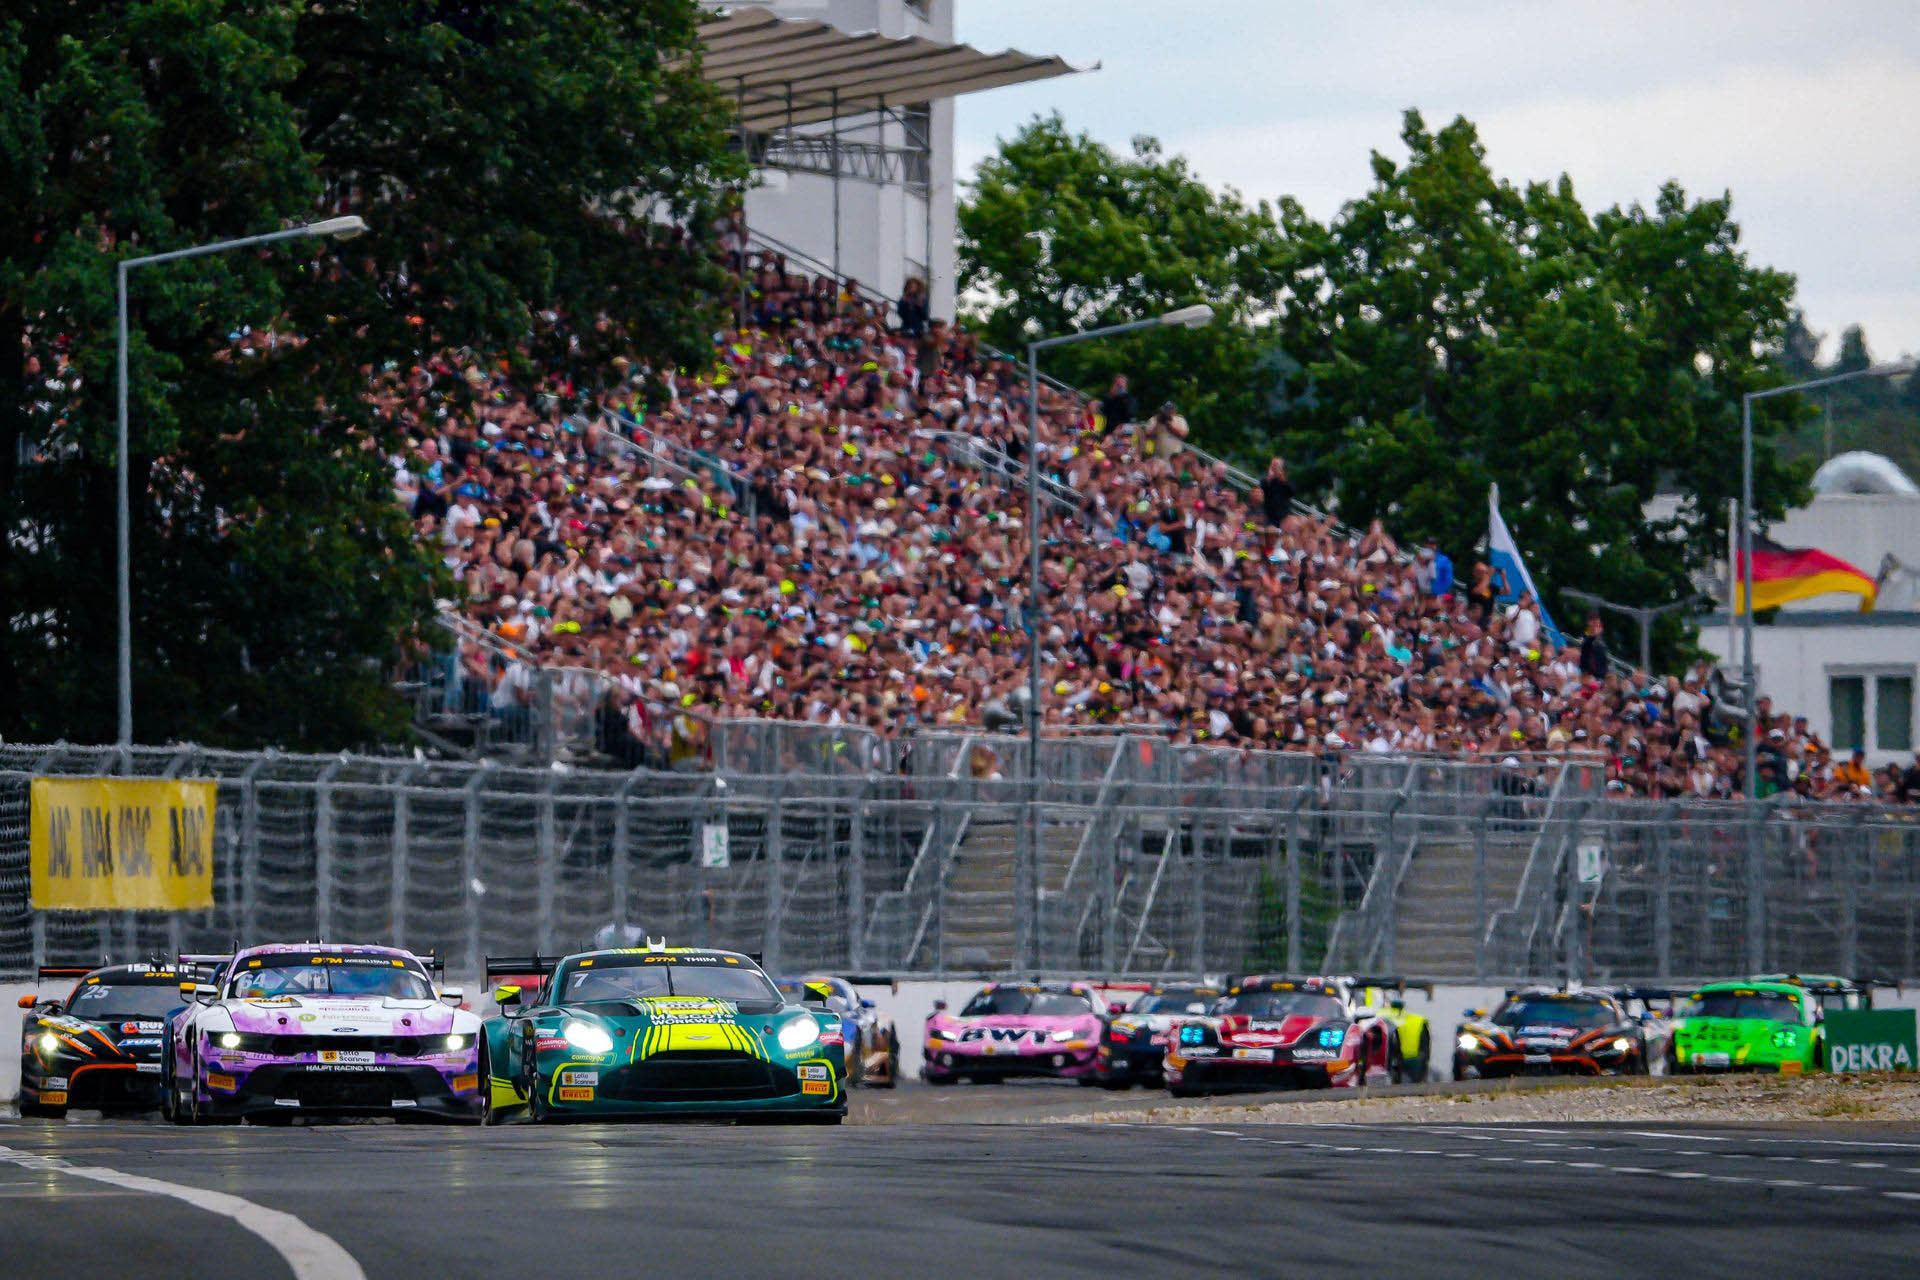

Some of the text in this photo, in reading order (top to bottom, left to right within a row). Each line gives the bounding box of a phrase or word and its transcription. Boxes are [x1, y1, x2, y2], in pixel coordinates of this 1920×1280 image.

[311, 957, 343, 965] DTM
[239, 971, 266, 988] 64
[573, 973, 589, 988] 7
[81, 985, 112, 999] 25
[537, 1039, 568, 1047] CHAMPION
[571, 1054, 606, 1063] comtoyou
[1830, 1043, 1910, 1073] DEKRA
[365, 1065, 386, 1073] TEAM
[804, 1082, 829, 1092] PIRELLI
[561, 1089, 592, 1098] PIRELLI
